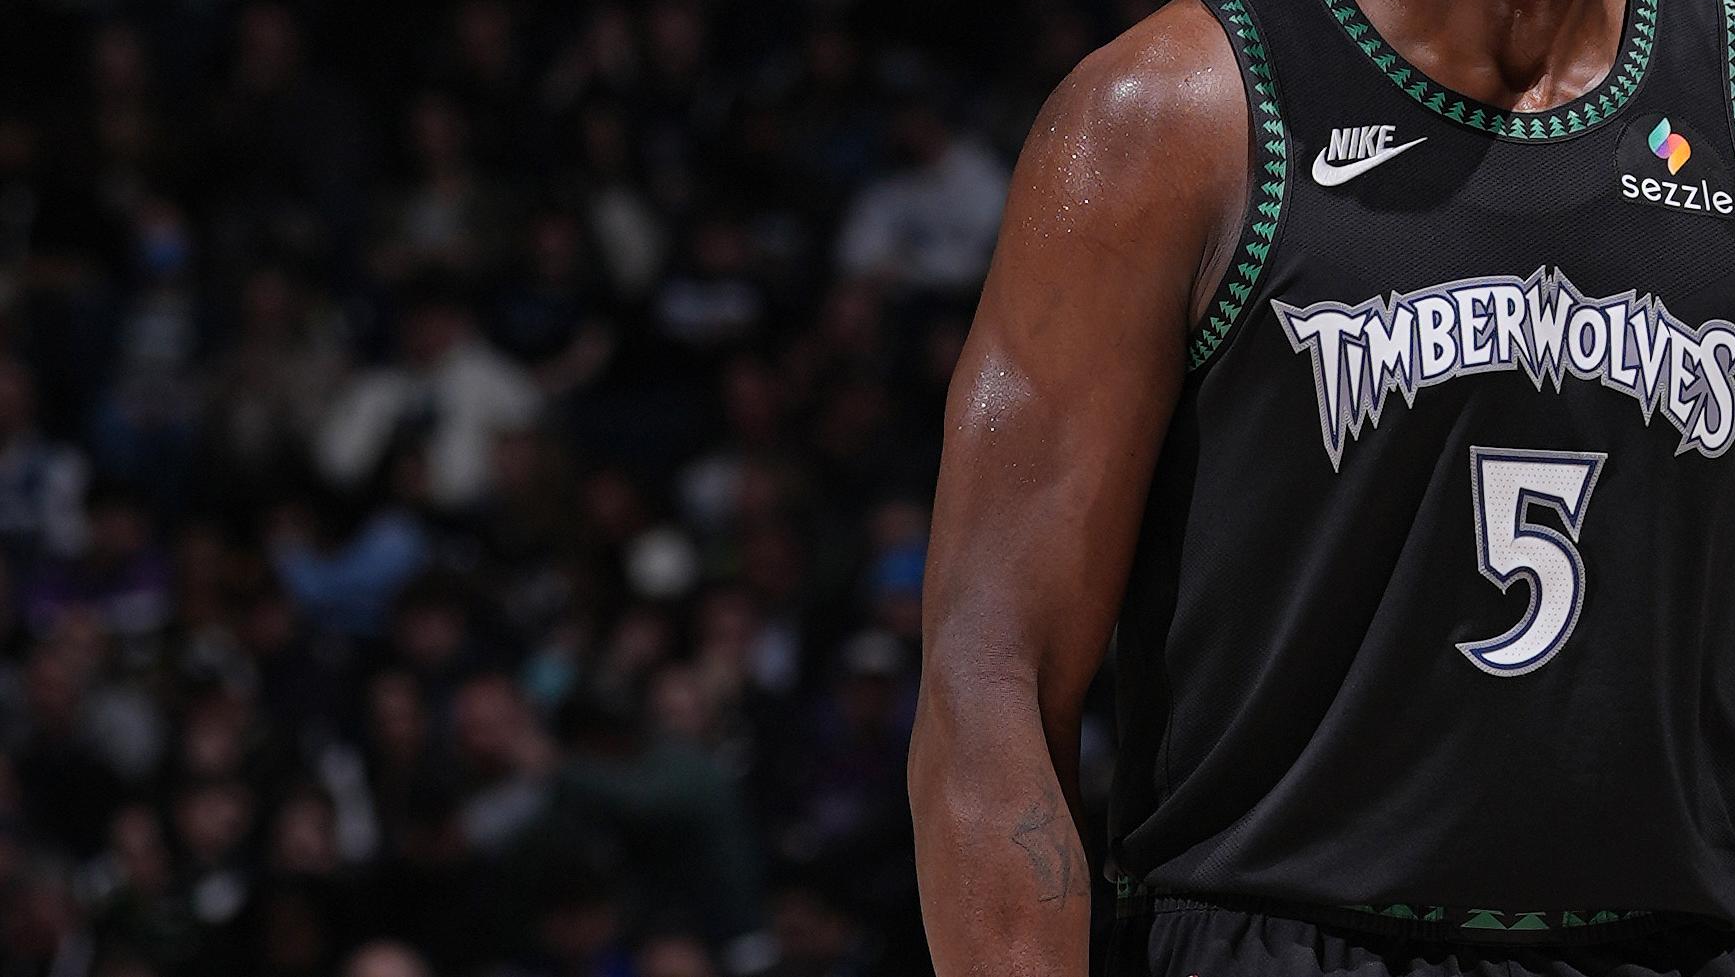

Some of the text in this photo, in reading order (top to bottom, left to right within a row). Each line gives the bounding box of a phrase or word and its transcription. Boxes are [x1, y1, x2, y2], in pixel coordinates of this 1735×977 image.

[1328, 125, 1396, 161] NIKE
[1621, 173, 1734, 214] sezzle
[1455, 446, 1608, 677] 5
